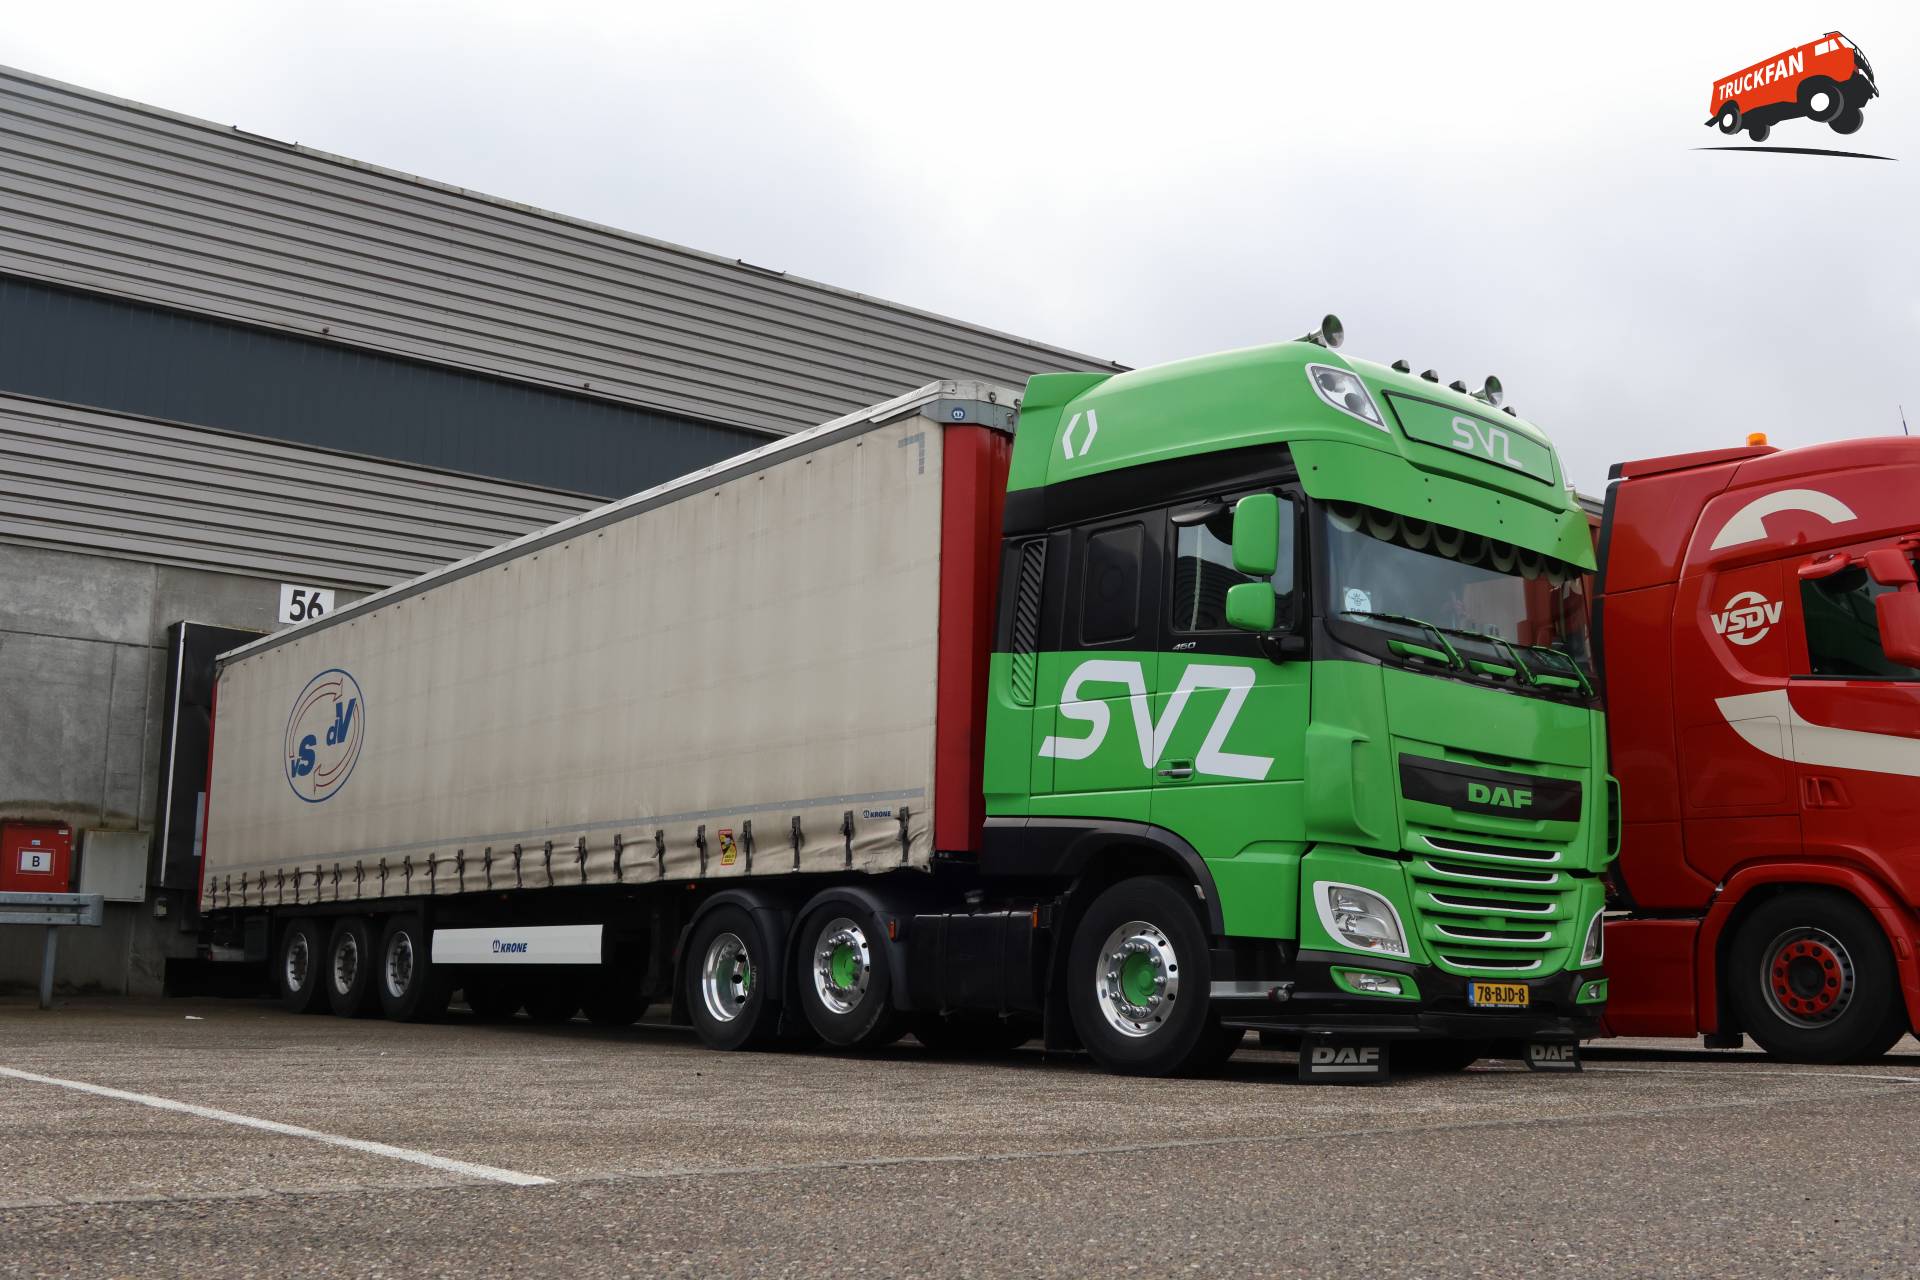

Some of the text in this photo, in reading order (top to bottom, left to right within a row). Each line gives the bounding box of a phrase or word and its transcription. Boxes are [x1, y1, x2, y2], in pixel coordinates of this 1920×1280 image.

[290, 590, 324, 621] 56
[1710, 601, 1783, 634] VSDV
[1038, 659, 1275, 780] SVZ
[1468, 782, 1532, 809] DAF
[870, 810, 891, 818] KRONE
[32, 855, 41, 867] B
[500, 942, 528, 953] KRONE
[1477, 986, 1525, 1002] 78-BJD-8
[1311, 1047, 1380, 1064] DAF
[1530, 1045, 1574, 1060] DAF
